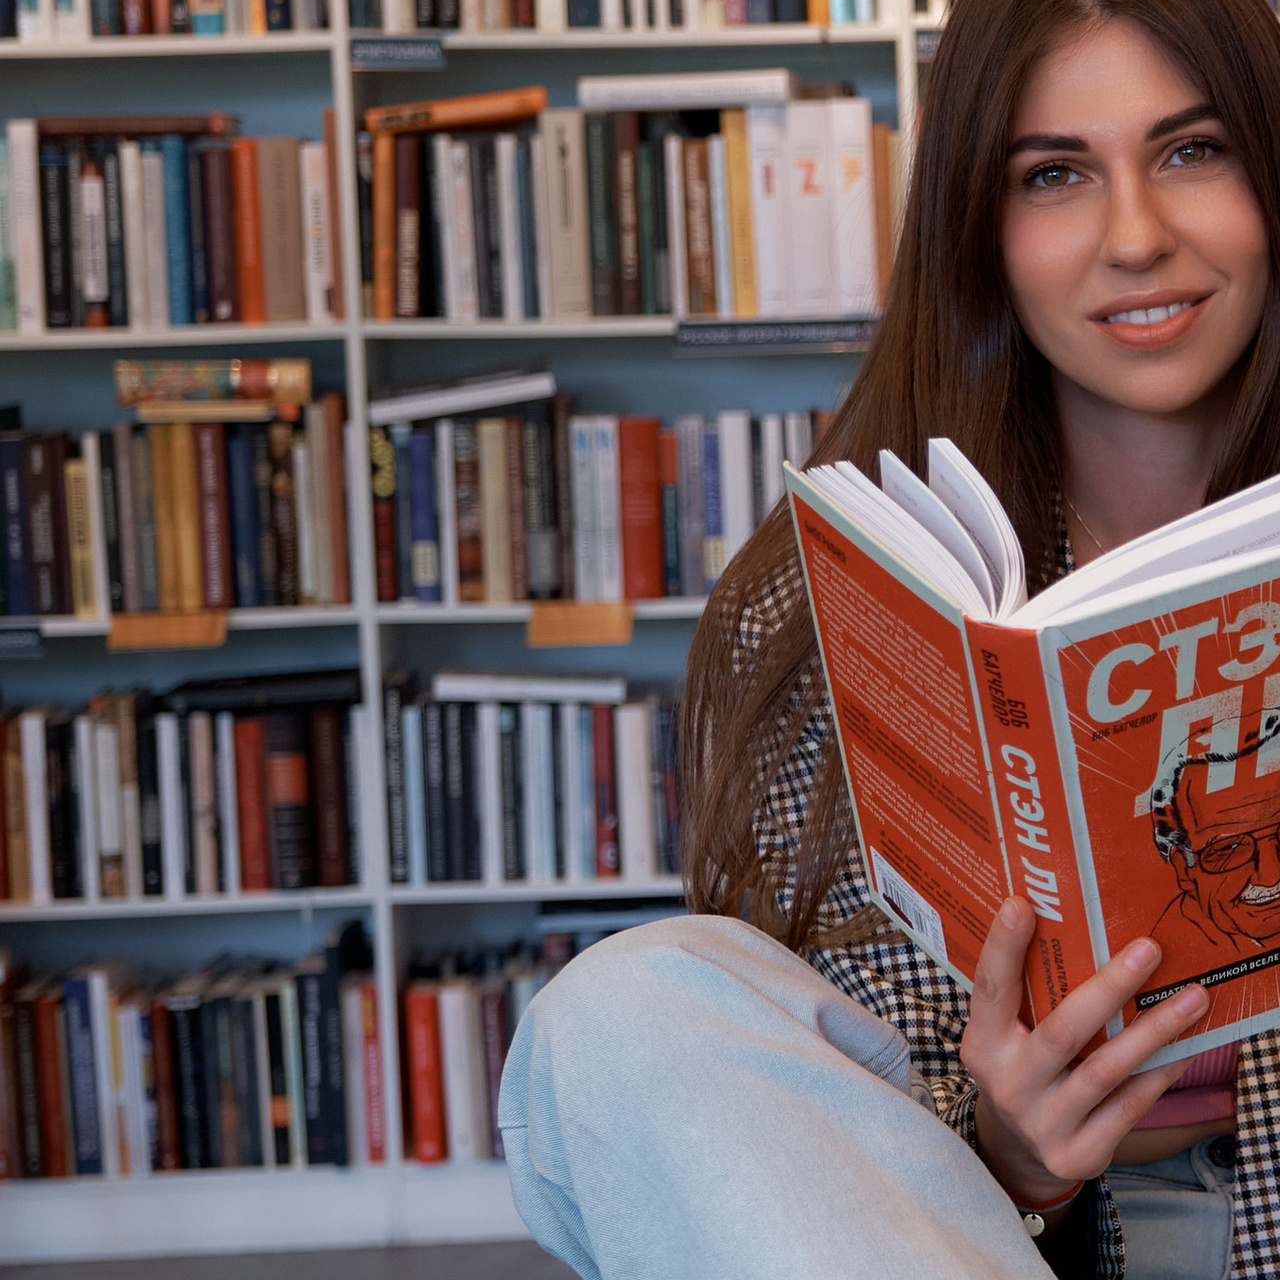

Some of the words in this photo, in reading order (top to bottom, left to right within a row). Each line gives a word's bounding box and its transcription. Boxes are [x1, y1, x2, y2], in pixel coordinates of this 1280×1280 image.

[982, 649, 1010, 727] БАТЧЕЛОР
[1007, 699, 1030, 729] БОБ
[1113, 712, 1159, 734] БАТЧЕЛОР
[1001, 743, 1051, 853] СТЭН
[1021, 855, 1064, 923] ЛИ
[1051, 937, 1069, 994] СОЗДАТЕЛЬ
[1199, 963, 1248, 987] ВЕЛИКОЙ
